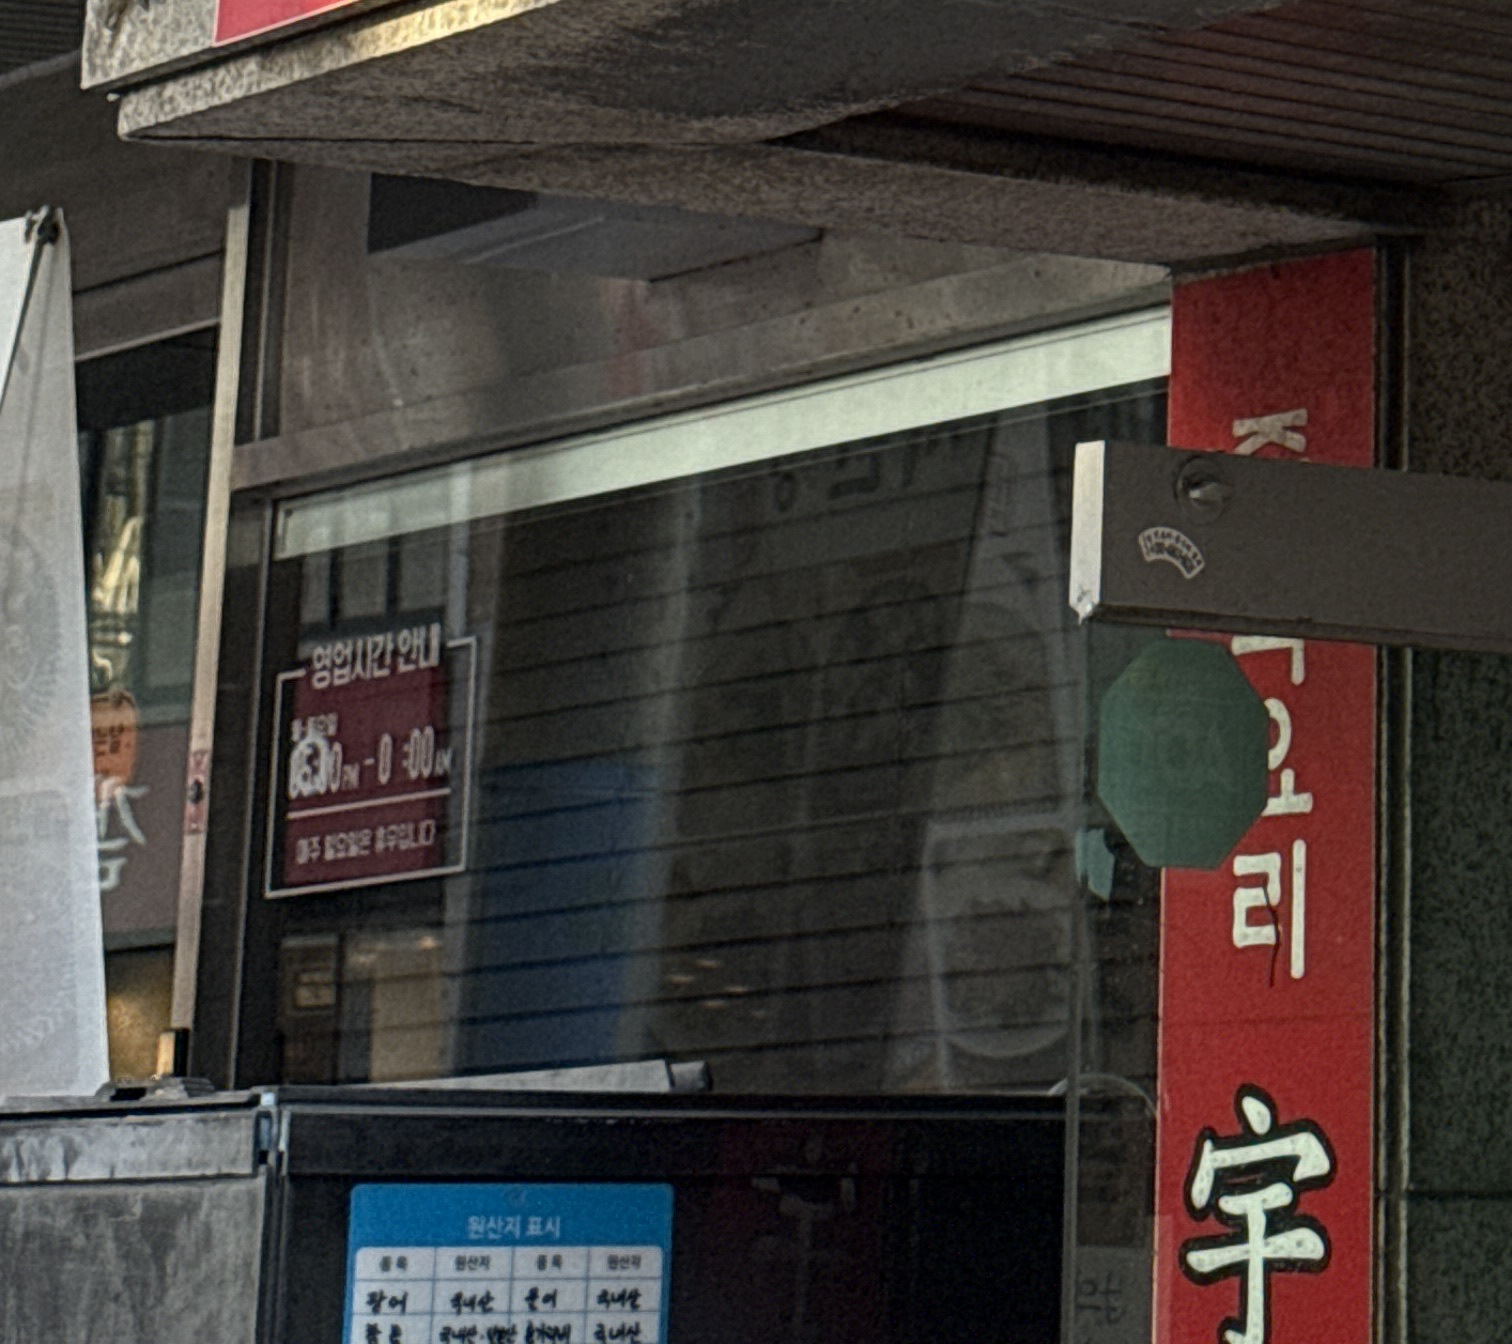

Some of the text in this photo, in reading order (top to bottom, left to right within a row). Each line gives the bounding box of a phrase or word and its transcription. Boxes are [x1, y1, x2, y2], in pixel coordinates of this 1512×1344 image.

[311, 621, 440, 690] 영업시간 안내
[467, 1215, 561, 1240] 원산지 표시
